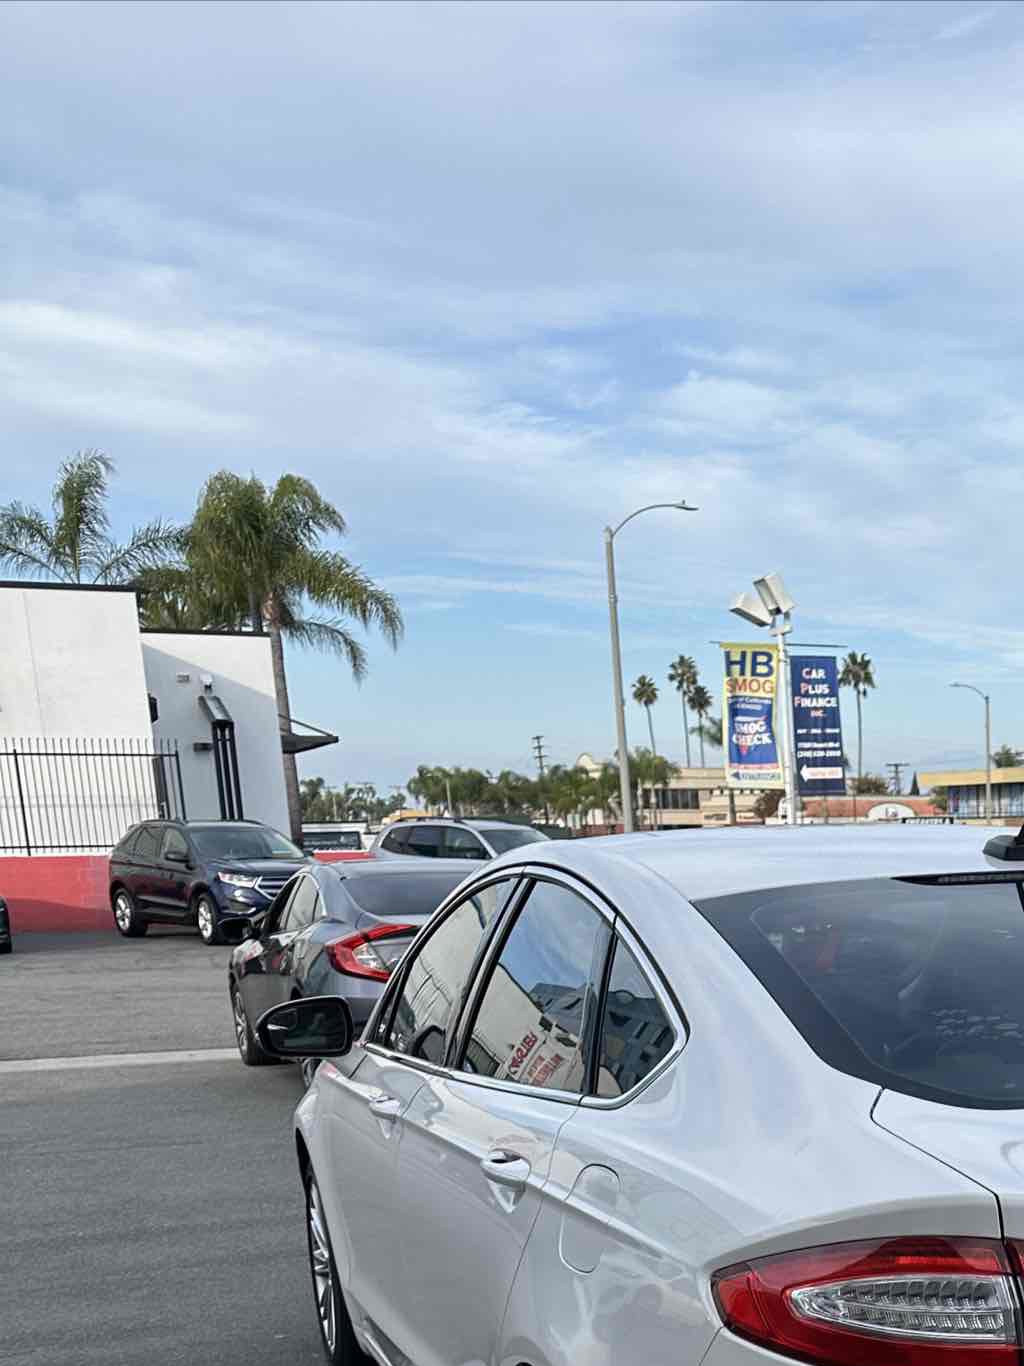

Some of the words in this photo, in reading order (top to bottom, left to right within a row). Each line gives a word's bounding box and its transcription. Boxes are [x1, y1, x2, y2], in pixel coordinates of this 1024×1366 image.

[724, 651, 774, 677] HB
[802, 668, 826, 679] CAR
[725, 678, 774, 694] SMOG
[800, 682, 830, 694] PLUS
[794, 697, 837, 708] FINANCE
[735, 721, 768, 734] SMOG
